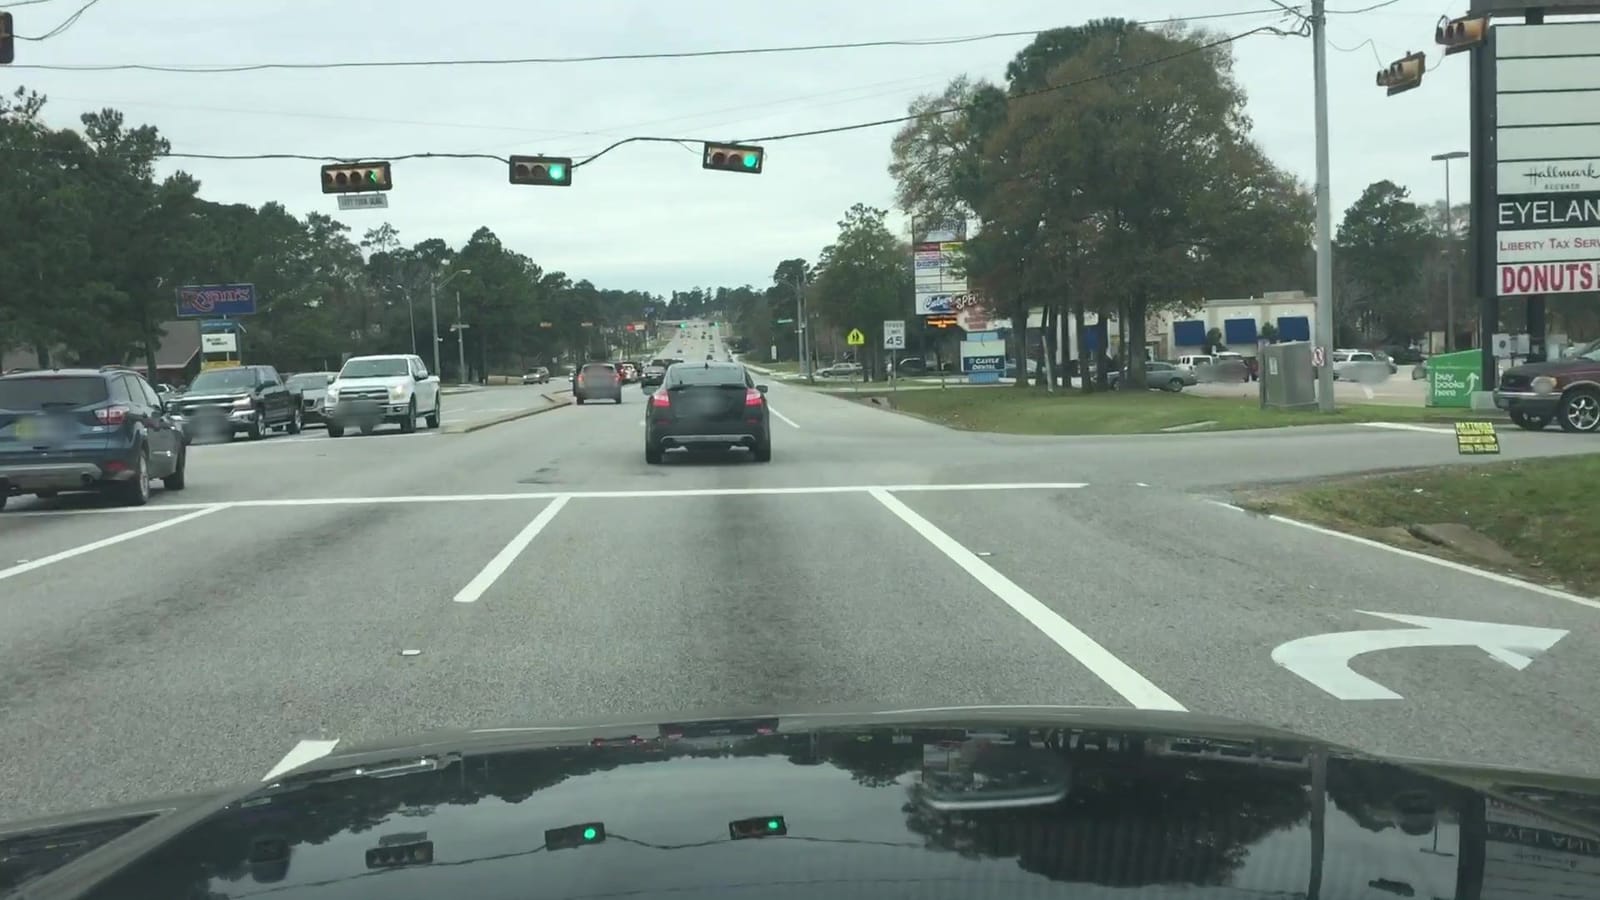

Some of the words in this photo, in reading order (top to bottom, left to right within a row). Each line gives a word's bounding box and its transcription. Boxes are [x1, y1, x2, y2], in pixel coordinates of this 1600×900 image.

[1522, 163, 1600, 186] Hallmark
[1502, 262, 1593, 294] DONUTS
[886, 336, 903, 346] 45
[1435, 372, 1454, 382] buy
[1435, 380, 1465, 389] books
[1435, 388, 1456, 397] here
